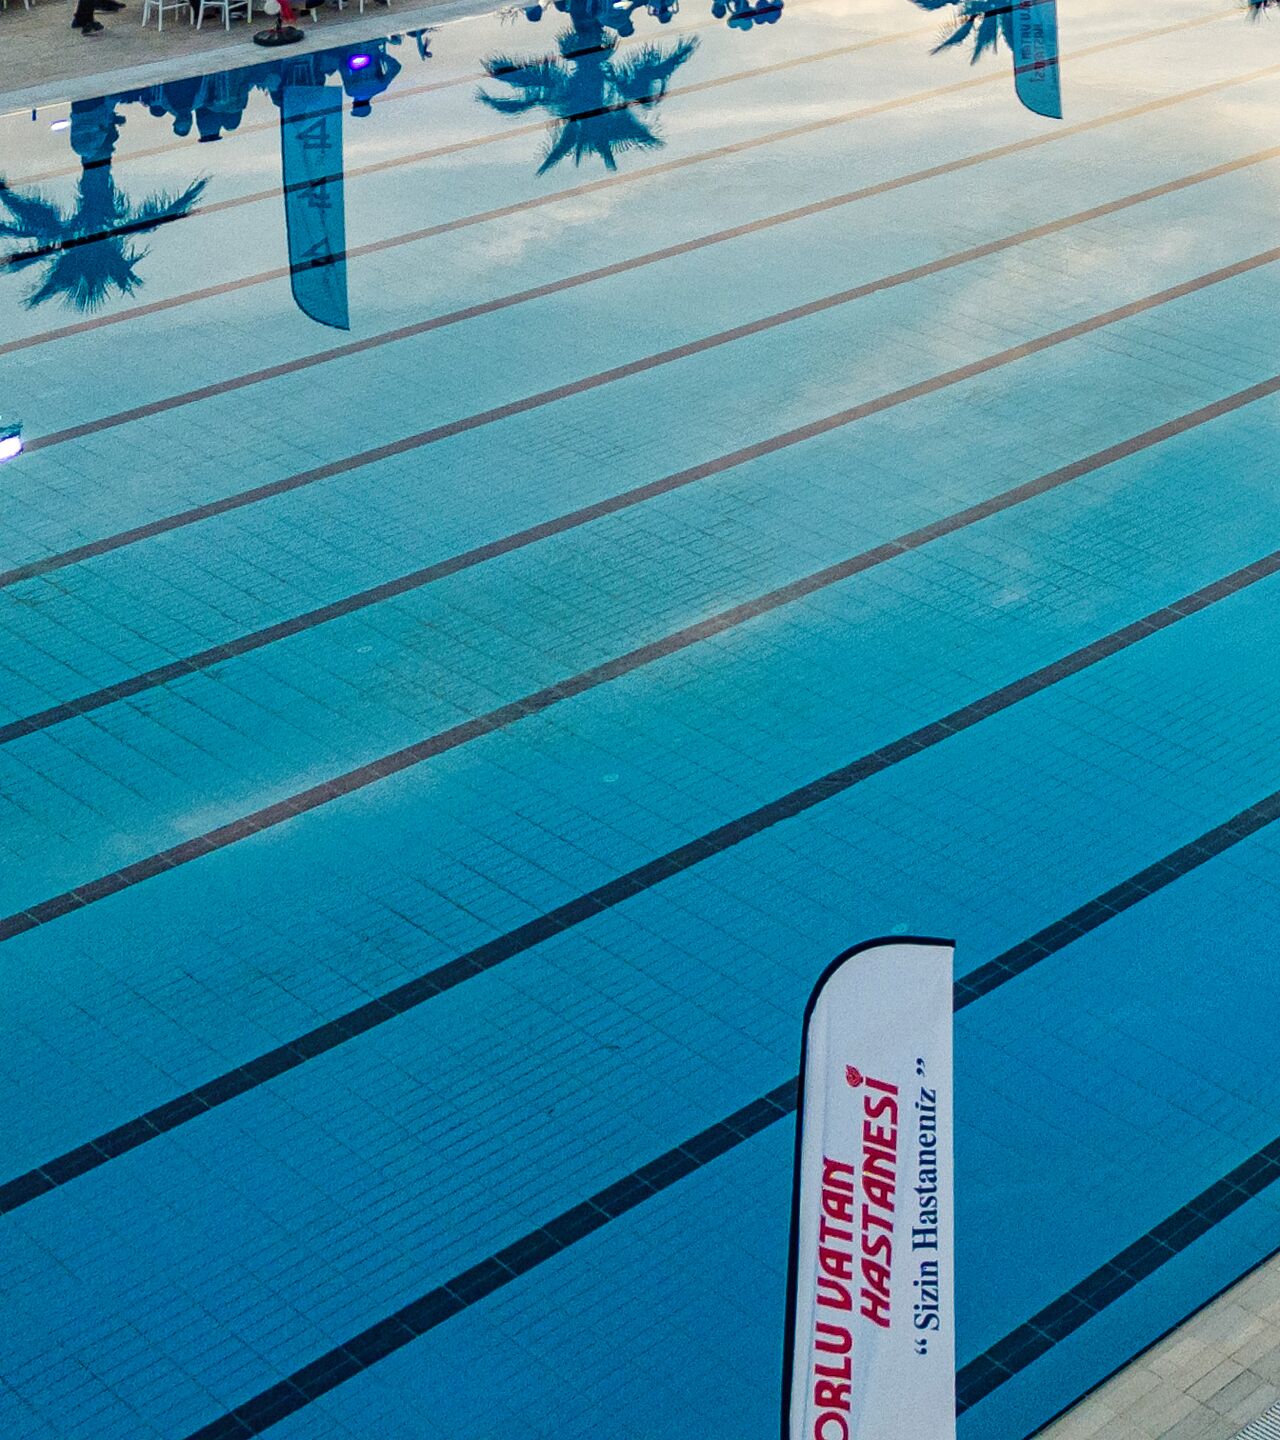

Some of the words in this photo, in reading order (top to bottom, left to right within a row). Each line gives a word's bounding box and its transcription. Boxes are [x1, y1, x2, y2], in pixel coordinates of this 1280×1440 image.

[816, 1157, 855, 1312] VATAN
[847, 1064, 899, 1328] HASTANESİ
[814, 1321, 853, 1440] ORLU
